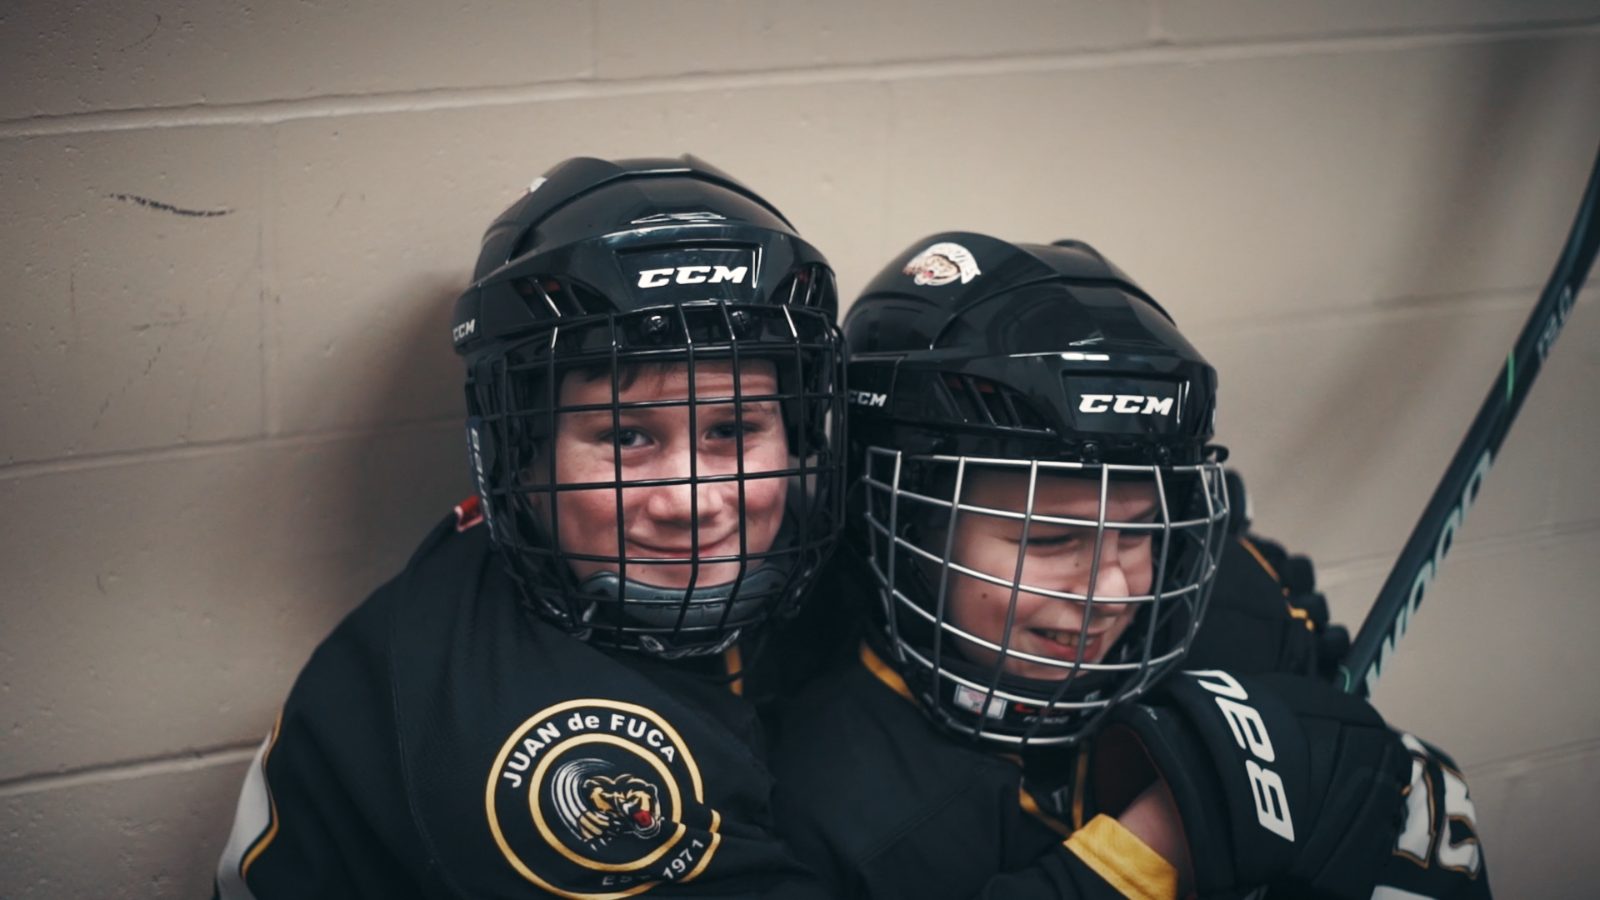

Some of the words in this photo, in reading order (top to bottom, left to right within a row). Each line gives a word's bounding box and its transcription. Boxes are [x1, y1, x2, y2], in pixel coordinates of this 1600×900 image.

[637, 265, 748, 289] CCM
[453, 318, 476, 341] CCM
[1078, 394, 1174, 416] CCM
[503, 722, 561, 789] JUAN
[568, 713, 600, 731] de
[610, 714, 676, 763] FUCA
[662, 838, 705, 880] 1971
